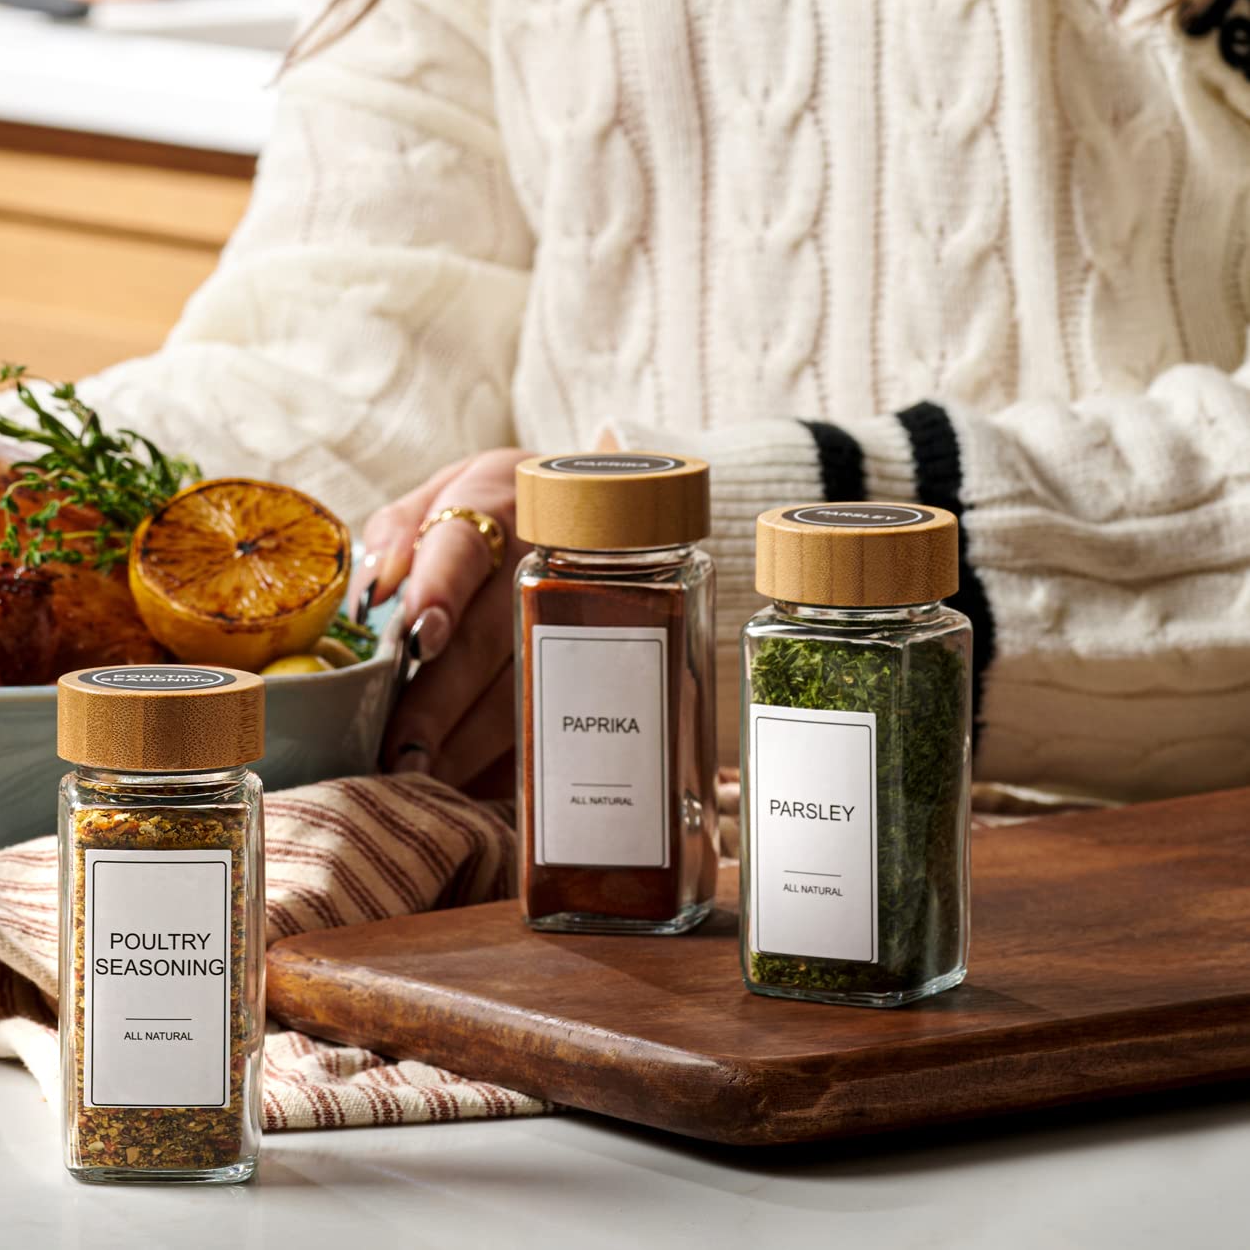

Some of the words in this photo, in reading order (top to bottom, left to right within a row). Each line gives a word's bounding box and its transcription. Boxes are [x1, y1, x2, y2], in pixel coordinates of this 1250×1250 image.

[816, 510, 898, 520] PARSLEY
[562, 716, 640, 734] PAPRIKA
[570, 794, 589, 805] ALL
[590, 796, 634, 807] NATURAL
[769, 799, 855, 823] PARSLEY
[782, 883, 799, 893] ALL
[800, 884, 844, 897] NATURAL
[110, 932, 211, 951] POULTRY
[95, 958, 224, 976] SEASONING
[123, 1030, 142, 1041] ALL
[145, 1030, 194, 1041] NATURAL
